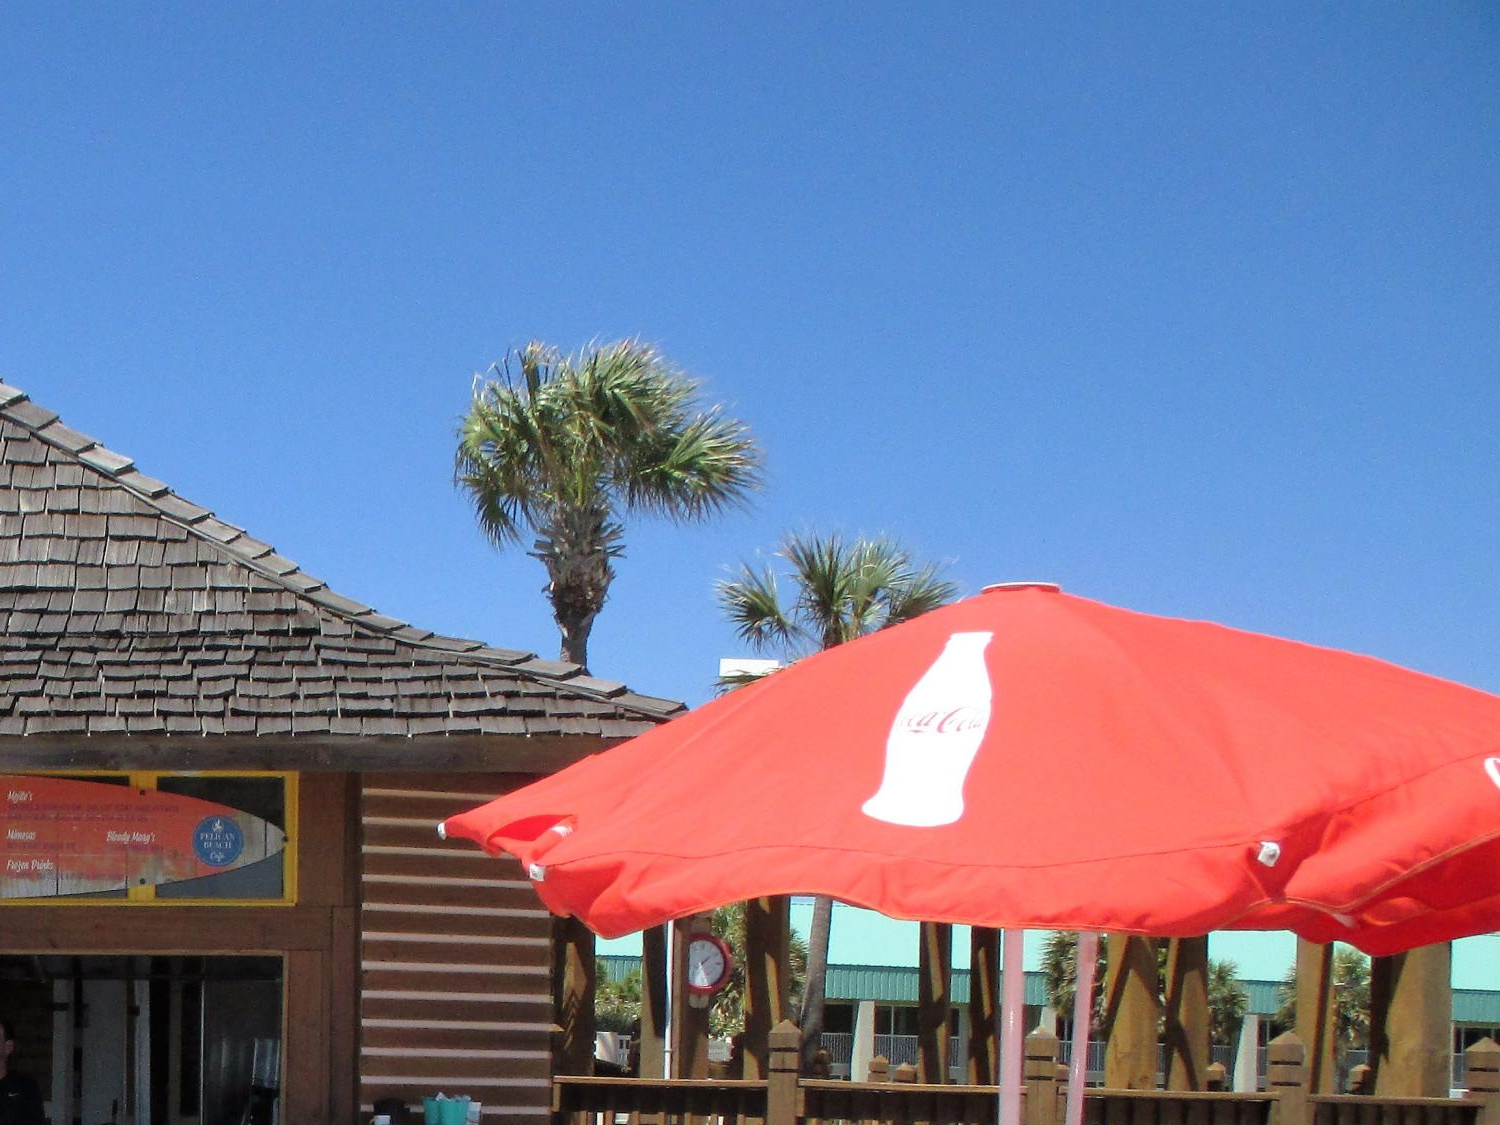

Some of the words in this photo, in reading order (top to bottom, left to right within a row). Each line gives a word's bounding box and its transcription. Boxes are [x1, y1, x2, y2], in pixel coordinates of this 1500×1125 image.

[6, 829, 37, 842] Mimosas
[106, 830, 131, 844] Bloody
[131, 831, 155, 845] Mary's
[199, 832, 236, 841] PELICAN
[203, 841, 232, 849] BEACH
[6, 858, 31, 873] Frozen
[30, 858, 54, 871] Drinks
